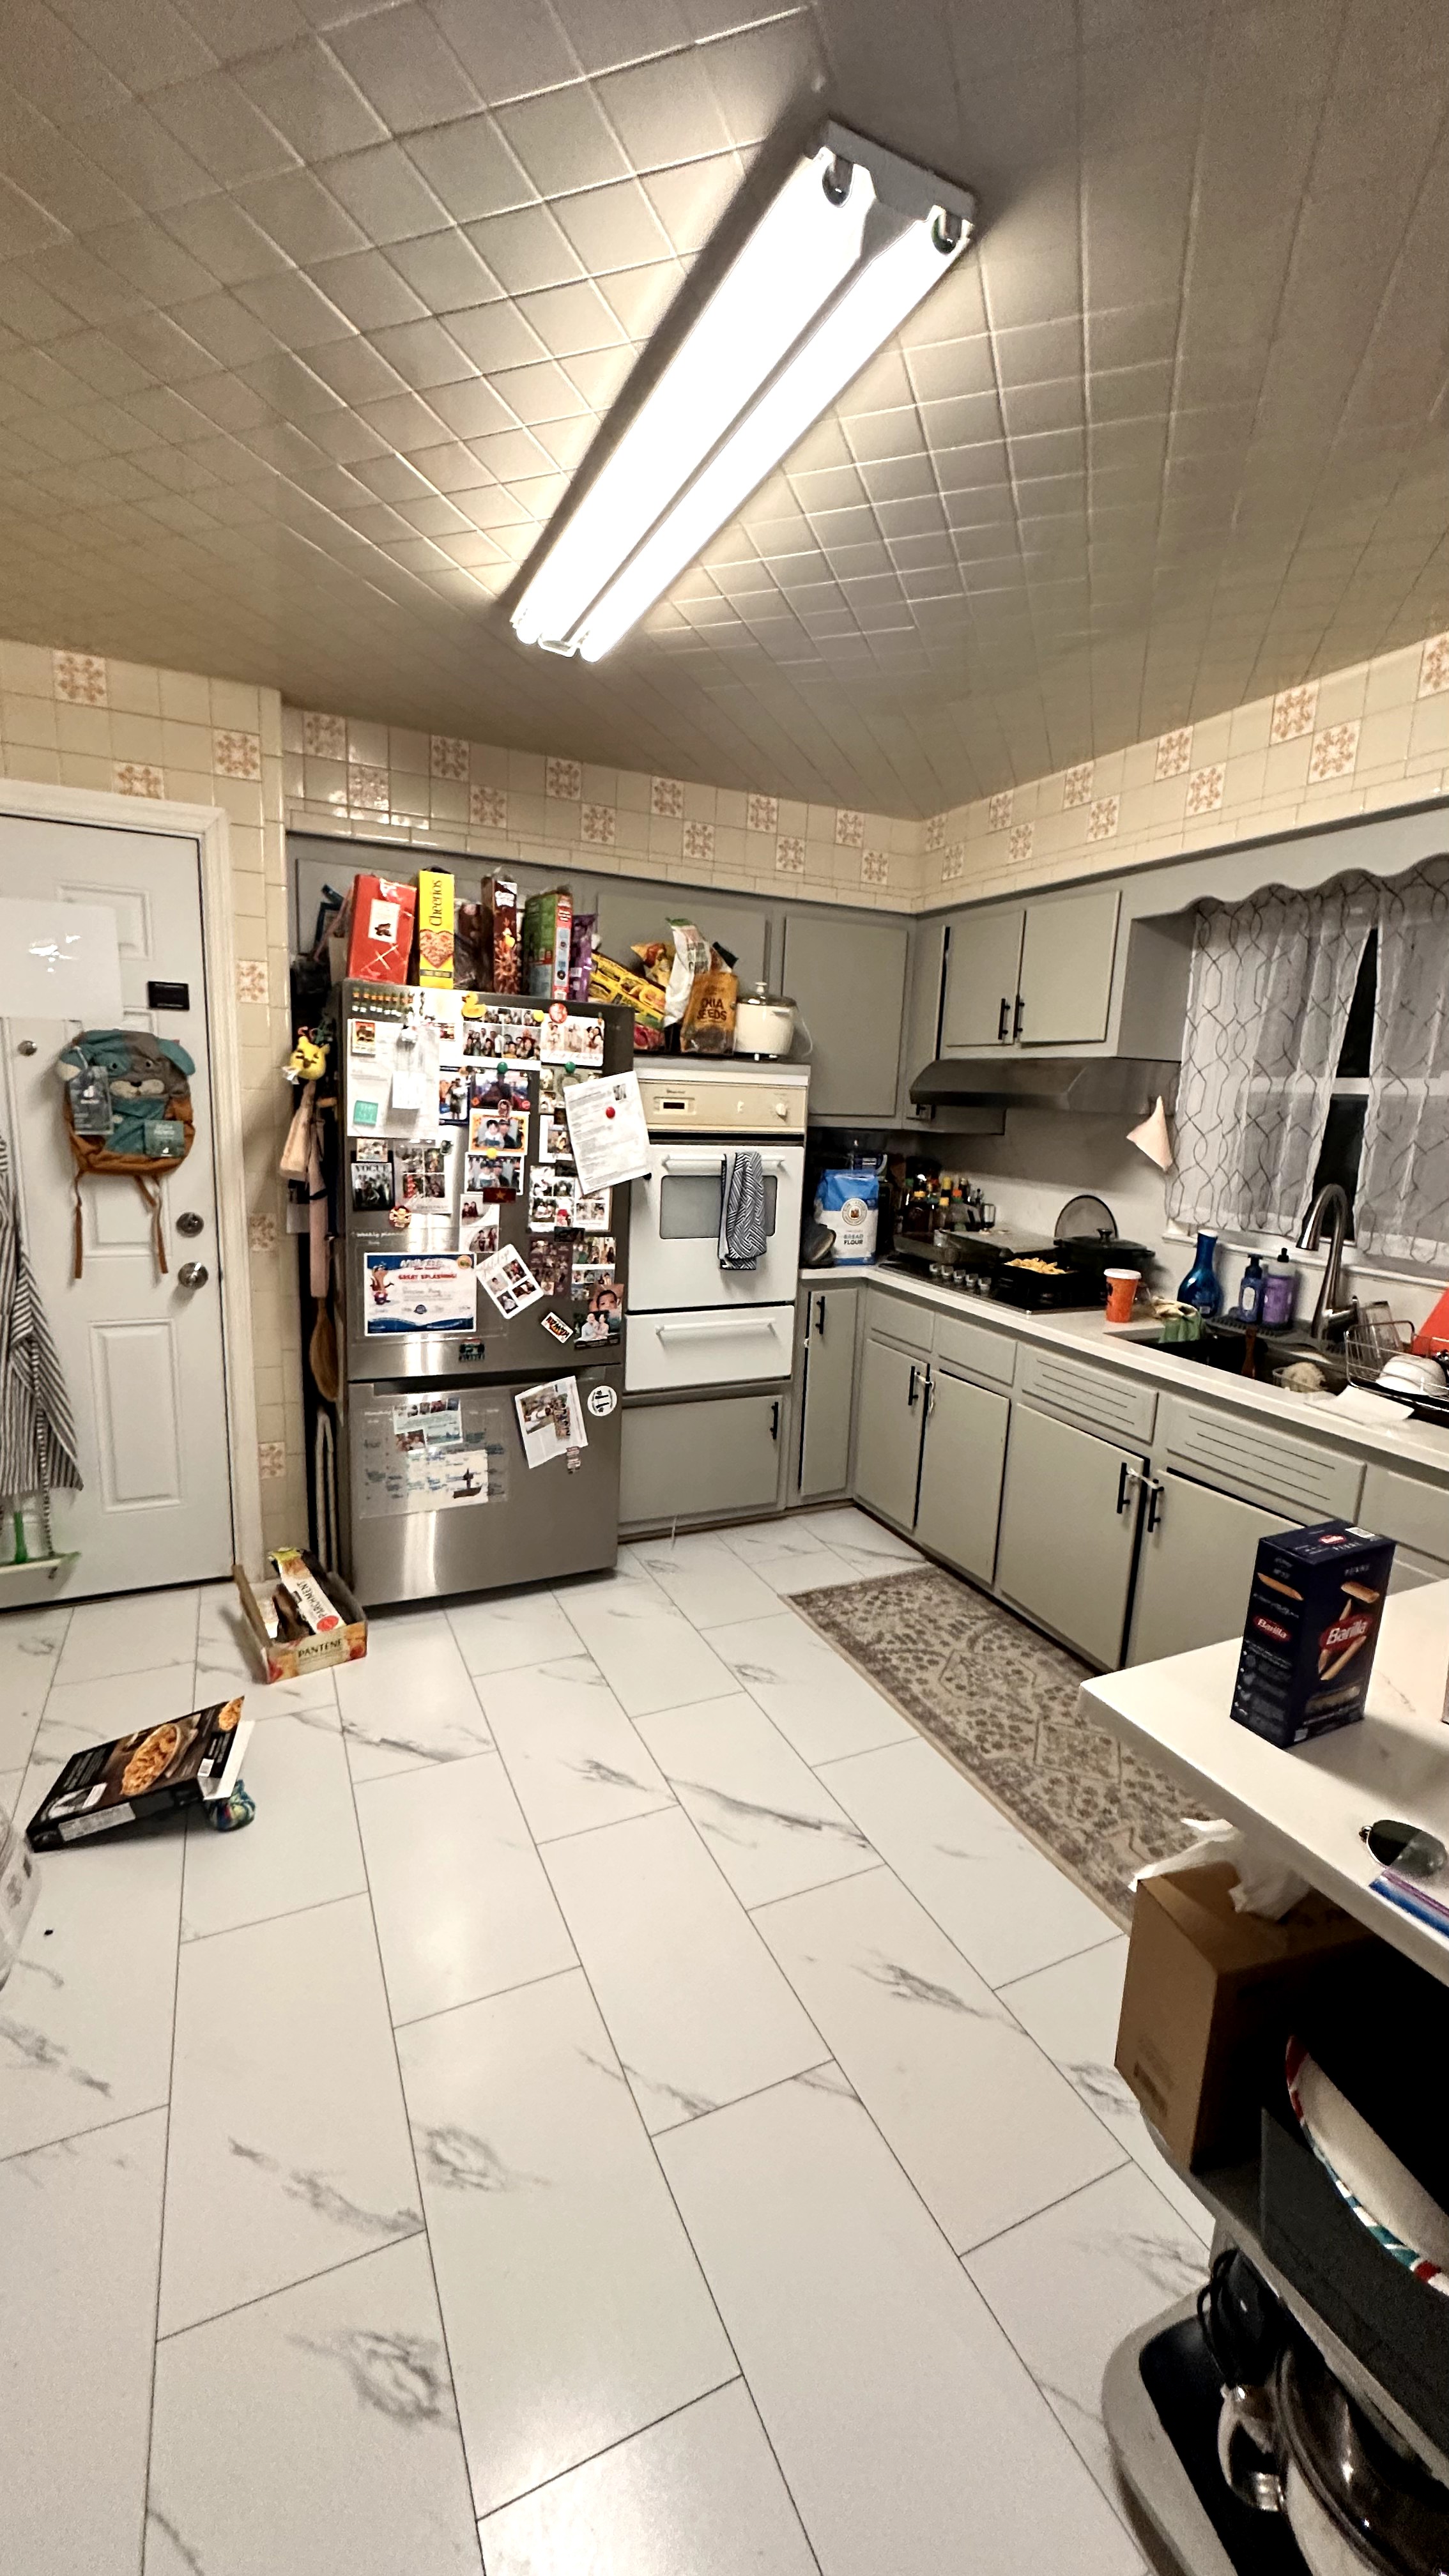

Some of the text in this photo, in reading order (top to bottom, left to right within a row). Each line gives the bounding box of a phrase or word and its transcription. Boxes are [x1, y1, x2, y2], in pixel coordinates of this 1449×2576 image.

[429, 880, 443, 926] Cheerios
[701, 997, 724, 1009] CHIA
[697, 1009, 727, 1021] SEEDS
[296, 1581, 328, 1619] PARCHMENT
[1257, 1618, 1287, 1639] Barilla
[1326, 1620, 1368, 1645] Barilla
[298, 1638, 342, 1658] PANTENE
